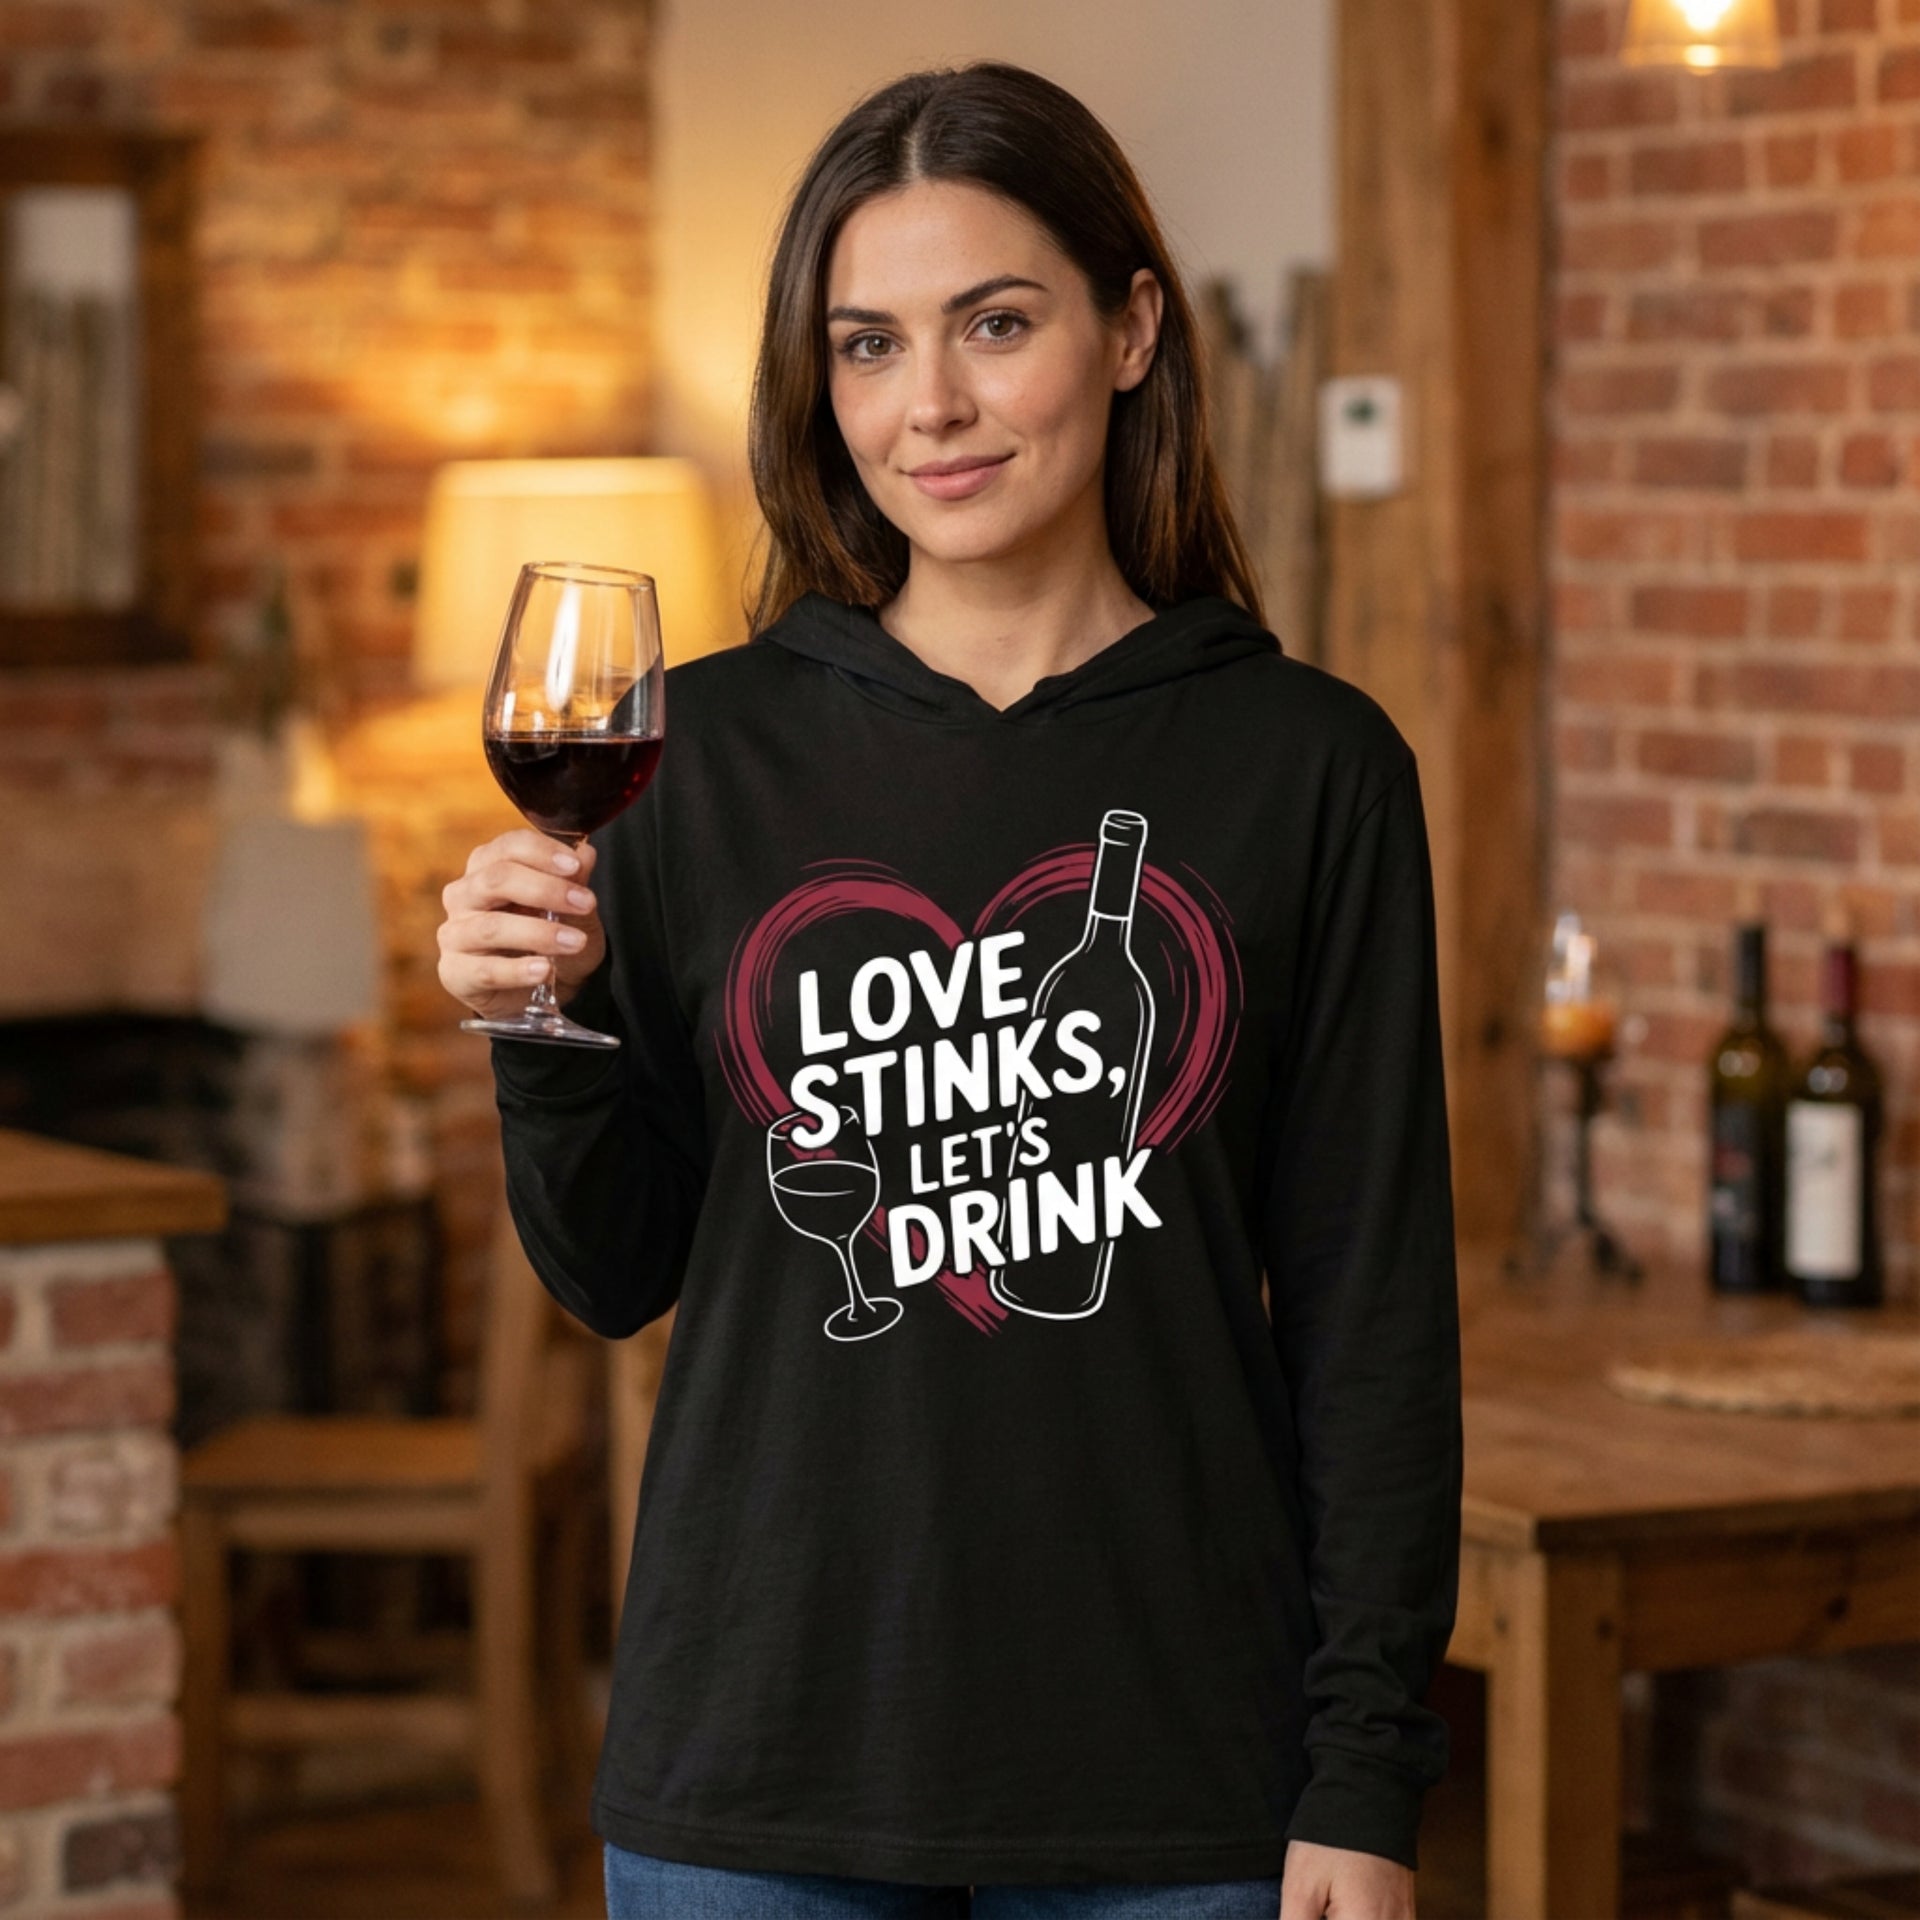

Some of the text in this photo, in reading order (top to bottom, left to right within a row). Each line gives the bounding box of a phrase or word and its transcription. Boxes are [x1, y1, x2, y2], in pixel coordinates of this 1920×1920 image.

[799, 931, 1028, 1056] LOVE
[790, 1009, 1126, 1149] STINKS,
[887, 1148, 1163, 1289] DRINK
[909, 1116, 1051, 1195] LET'S
